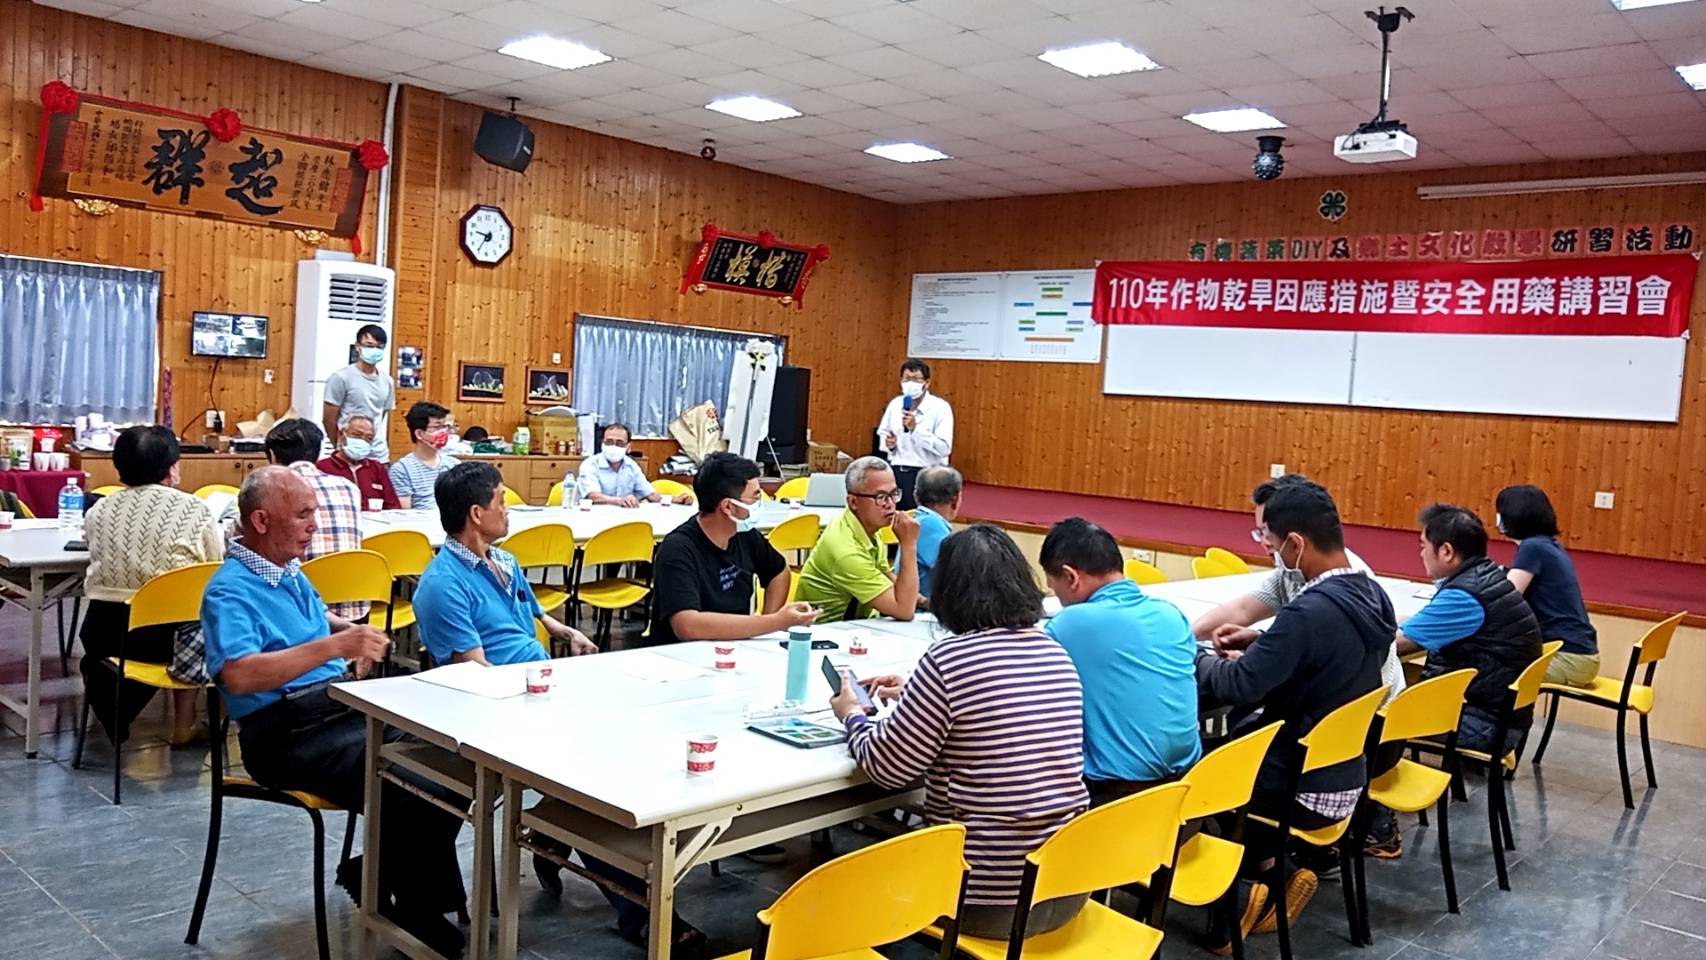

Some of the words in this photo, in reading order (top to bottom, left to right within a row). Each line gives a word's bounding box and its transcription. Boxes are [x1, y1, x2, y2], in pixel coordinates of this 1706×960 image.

[1108, 274, 1672, 316] 110年作物乾旱因應措施暨安全用藥講習會
